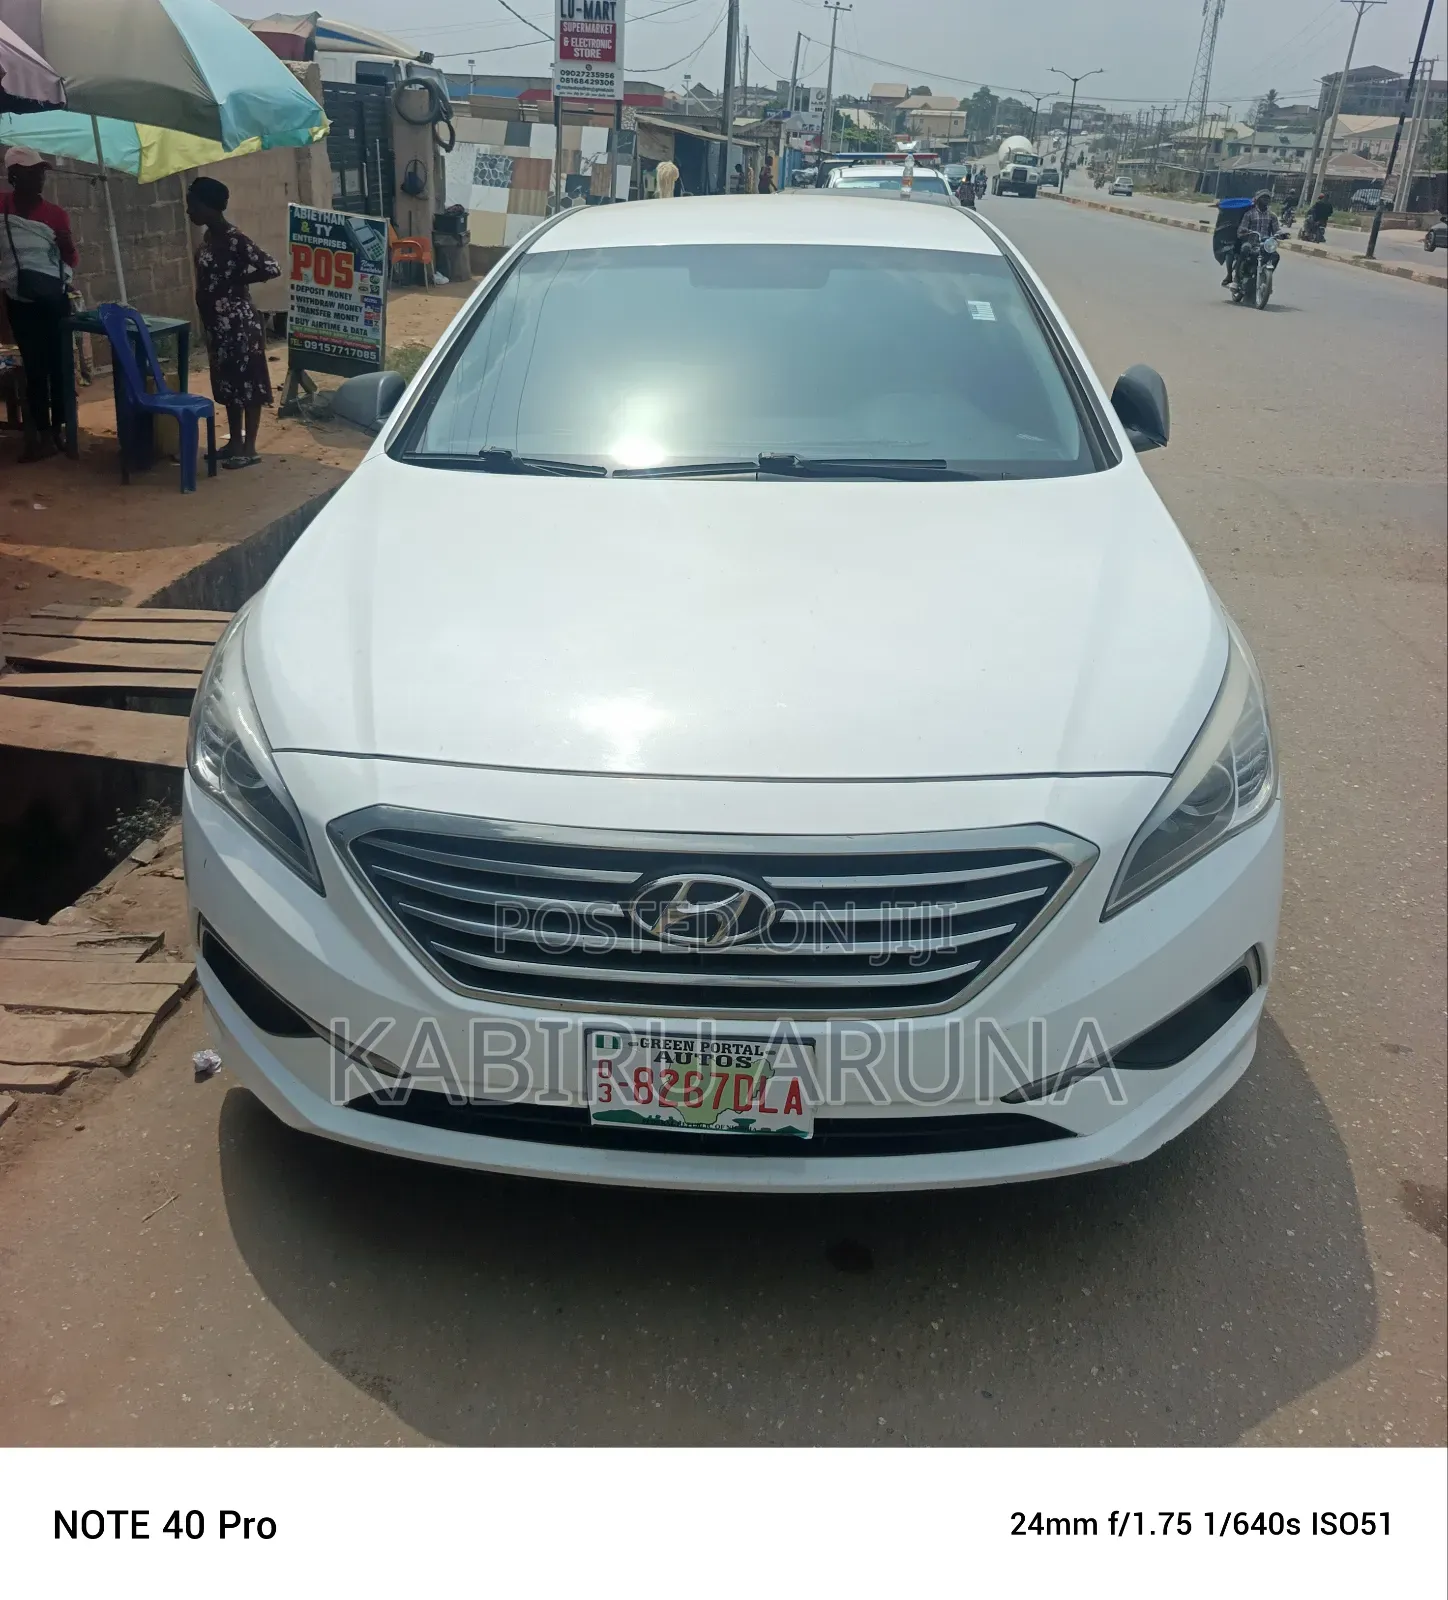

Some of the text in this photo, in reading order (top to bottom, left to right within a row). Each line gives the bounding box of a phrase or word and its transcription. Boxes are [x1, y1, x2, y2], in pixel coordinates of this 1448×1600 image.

[563, 22, 613, 35] SUPERMARKET
[563, 36, 613, 50] & ELECTRONIC
[573, 48, 602, 59] STORE
[560, 69, 615, 79] 09027235956
[560, 77, 615, 87] 08168429306
[293, 206, 346, 226] ABIETHAN
[301, 221, 333, 237] & TY
[292, 233, 347, 250] ENTERPRISES
[290, 242, 354, 290] POS
[296, 284, 353, 301] DEPOSIT MONEY
[296, 295, 363, 314] WITHDRAW MONEY
[297, 305, 359, 323] TRANSFER MONEY
[295, 317, 310, 326] BUY
[311, 320, 341, 332] AIRTIME
[350, 327, 368, 337] DATA
[304, 340, 377, 360] 09157717085
[640, 1038, 764, 1056] GREEN PORTAL
[653, 1050, 752, 1069] AUTOS
